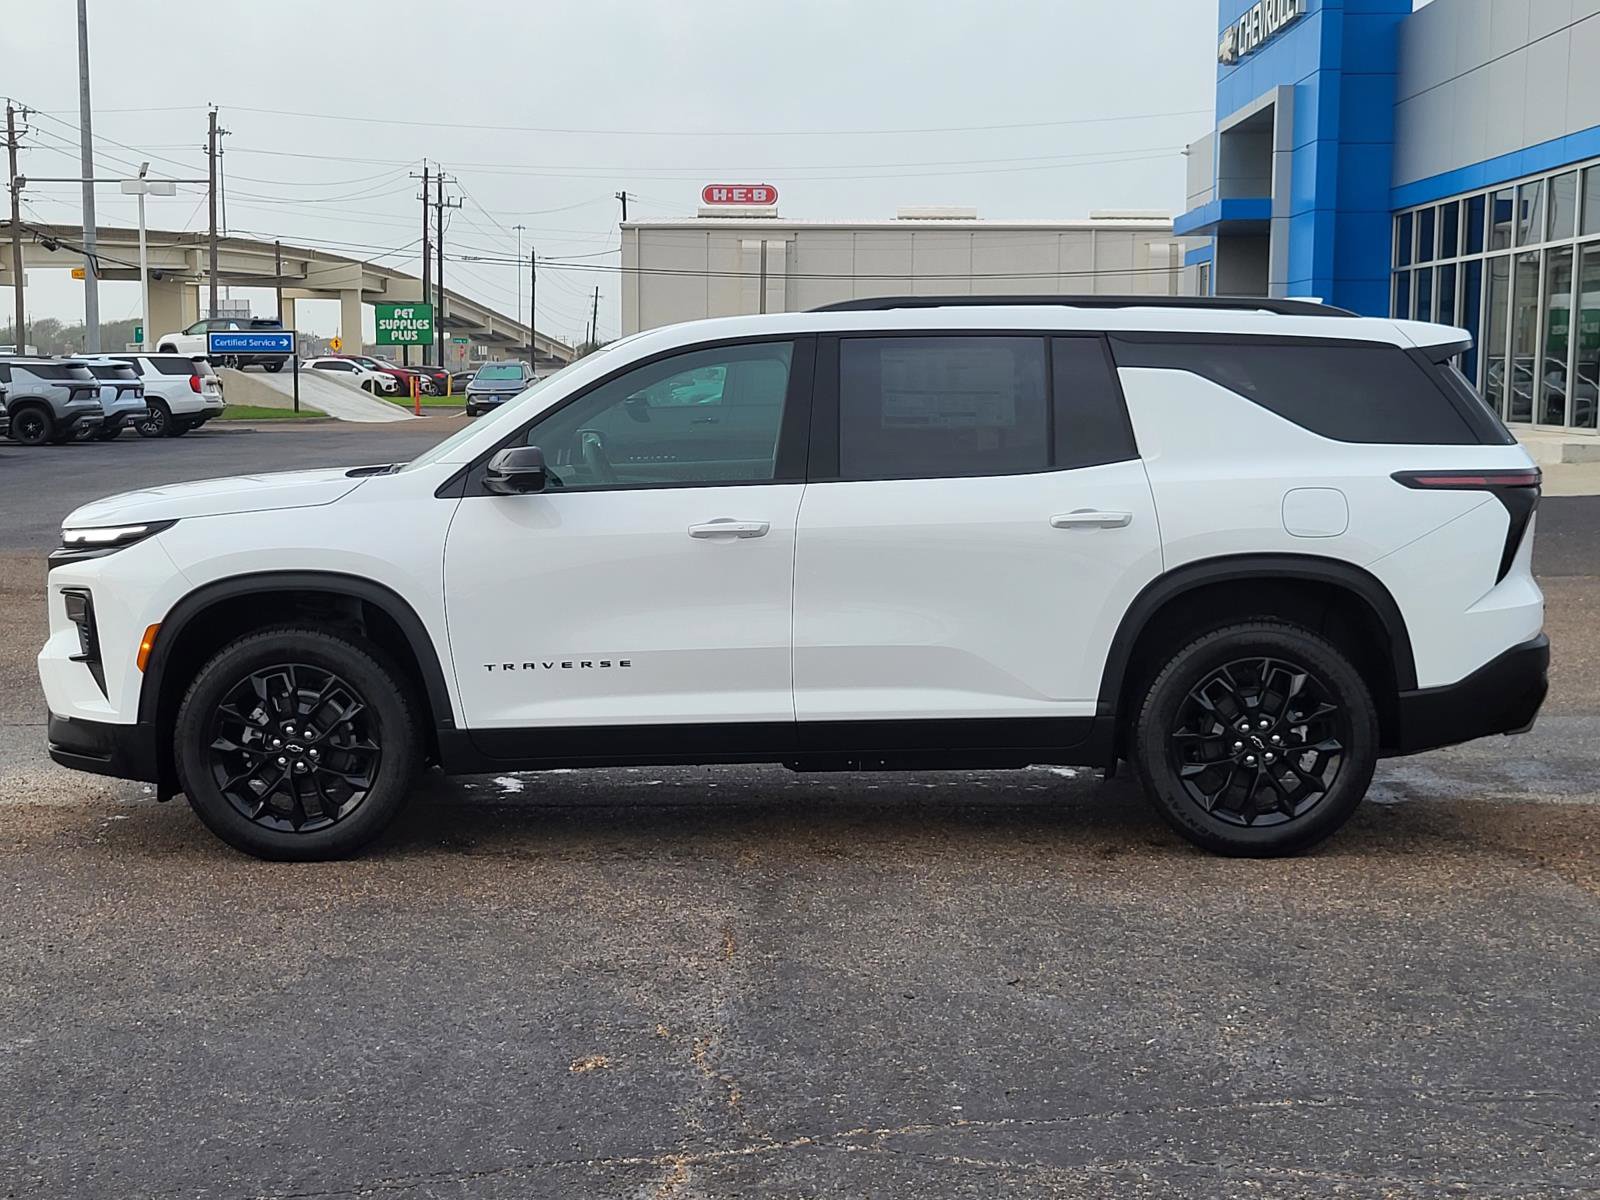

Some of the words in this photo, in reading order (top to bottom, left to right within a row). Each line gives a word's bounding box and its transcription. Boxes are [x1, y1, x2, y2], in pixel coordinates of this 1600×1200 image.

[394, 308, 414, 318] PET
[379, 319, 430, 330] SUPPLIES
[391, 330, 418, 341] PLUS
[214, 338, 247, 347] Certified
[248, 338, 276, 347] Service
[483, 660, 631, 672] TRAVERSE
